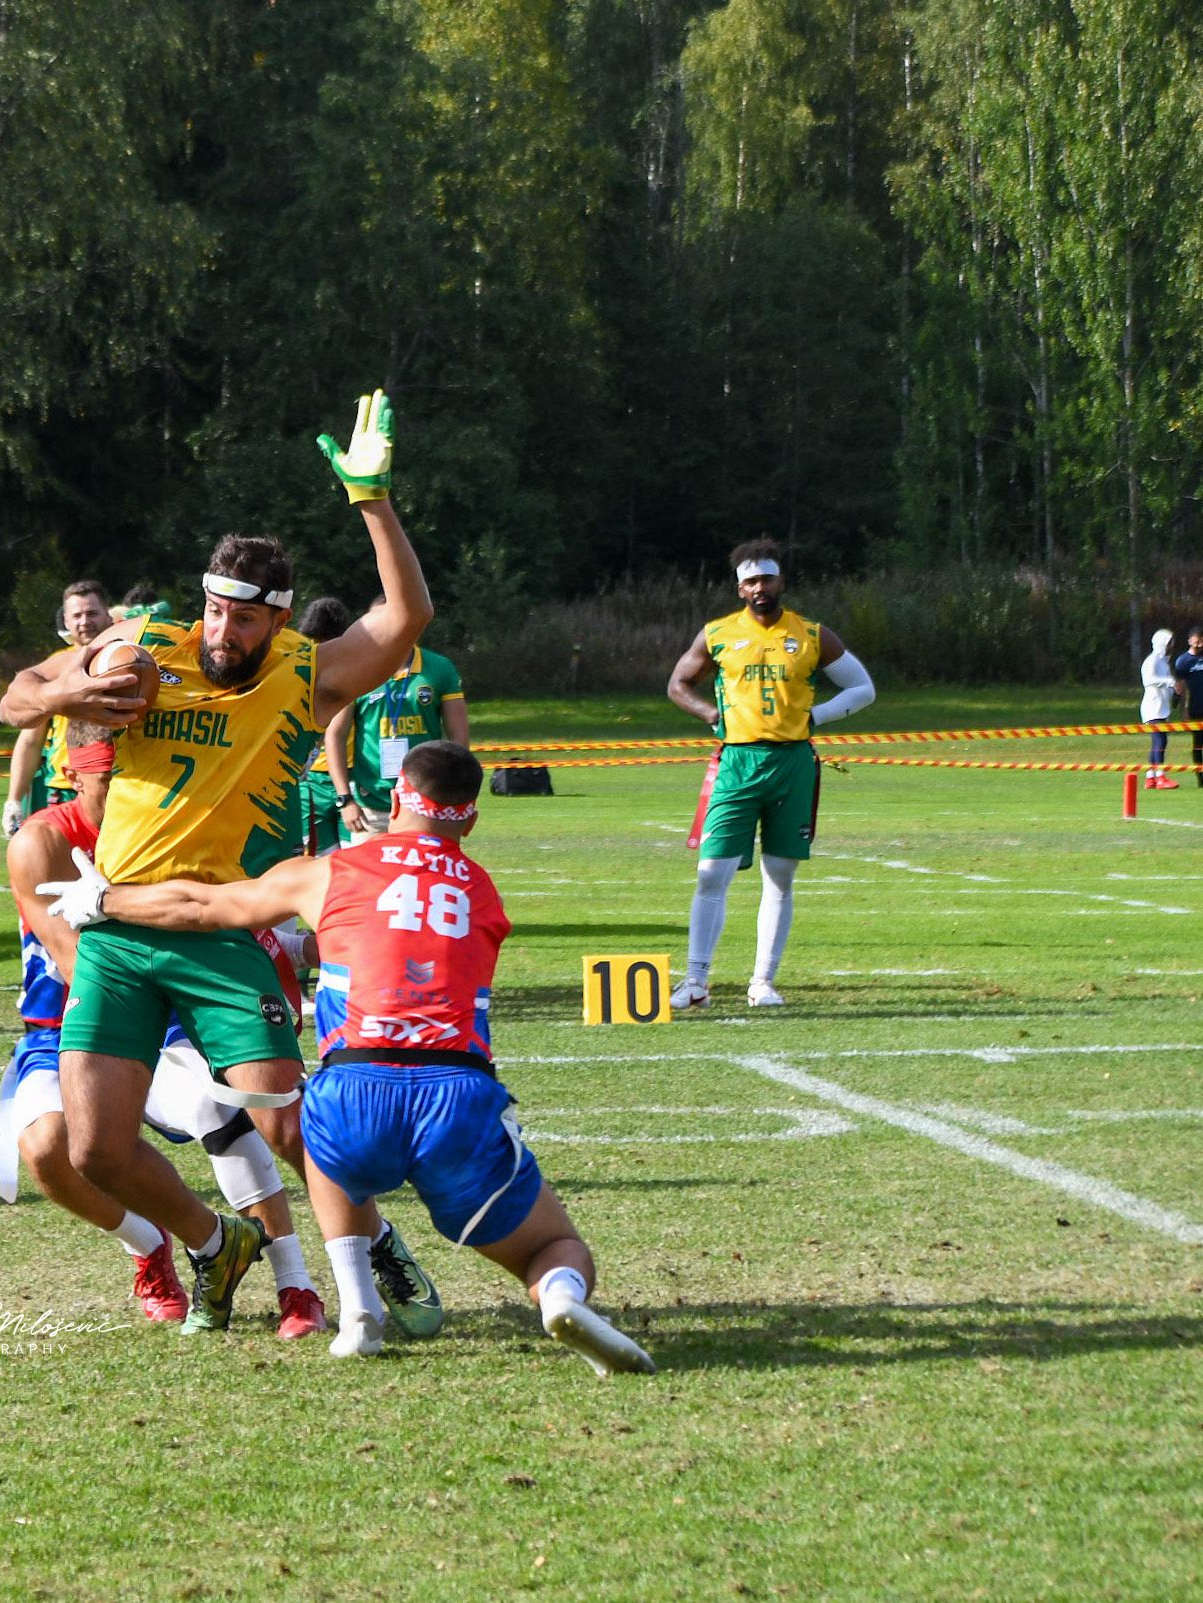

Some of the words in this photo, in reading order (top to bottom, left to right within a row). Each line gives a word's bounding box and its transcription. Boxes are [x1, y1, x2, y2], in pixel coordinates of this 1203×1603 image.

[744, 664, 789, 682] BRASIL
[761, 687, 775, 716] 5
[144, 709, 233, 747] BRASIL
[158, 754, 195, 810] 7
[380, 846, 471, 882] KATIĆ
[376, 873, 470, 939] 48
[592, 961, 660, 1024] 10
